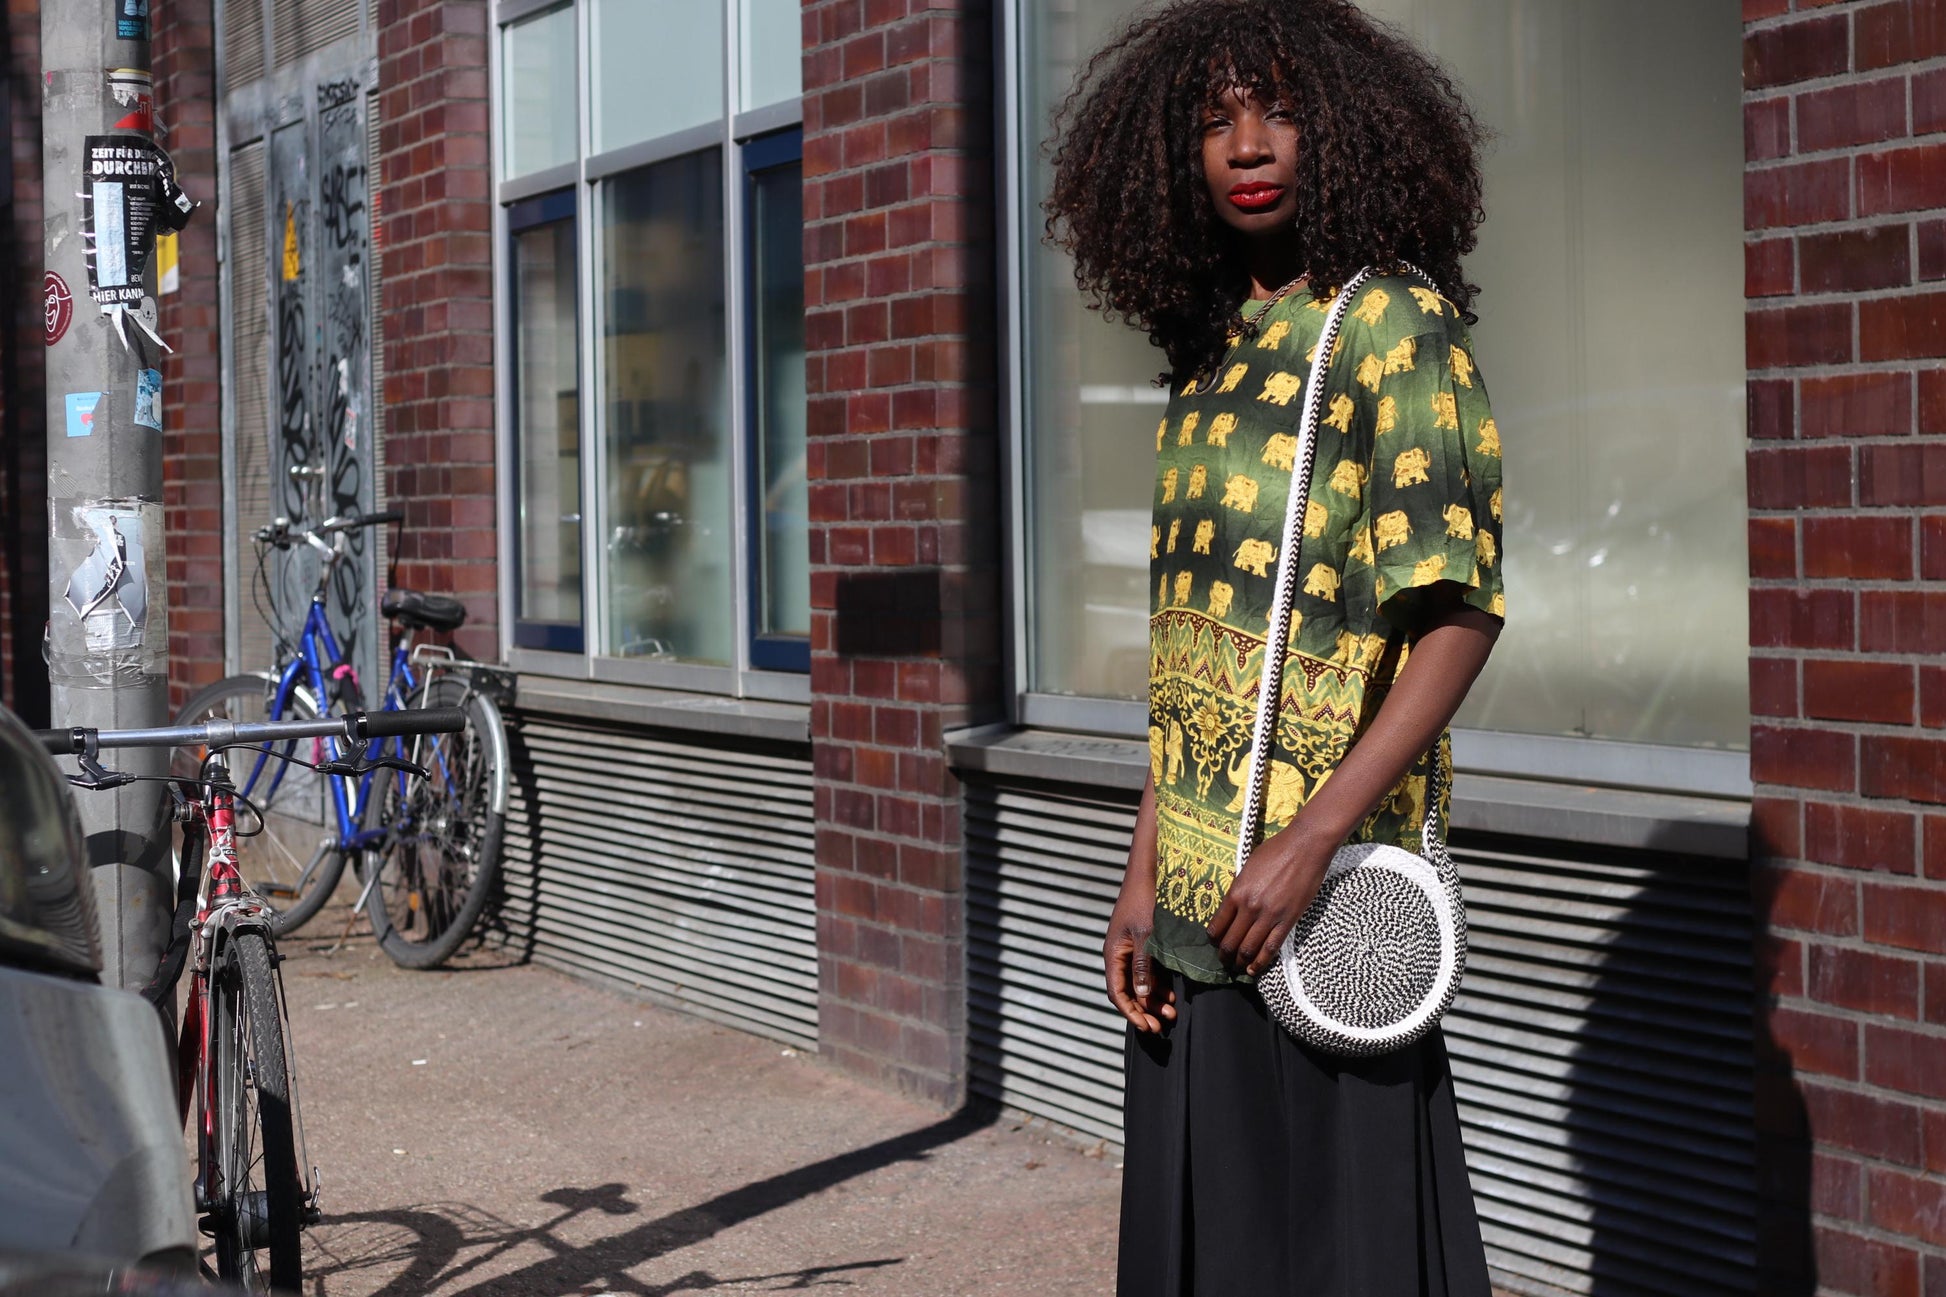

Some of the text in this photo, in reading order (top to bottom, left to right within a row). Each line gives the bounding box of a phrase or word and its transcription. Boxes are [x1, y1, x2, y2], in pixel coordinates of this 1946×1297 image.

[91, 147, 115, 159] ZEIT
[115, 145, 134, 159] FÜR
[93, 287, 145, 302] HIER KANN
